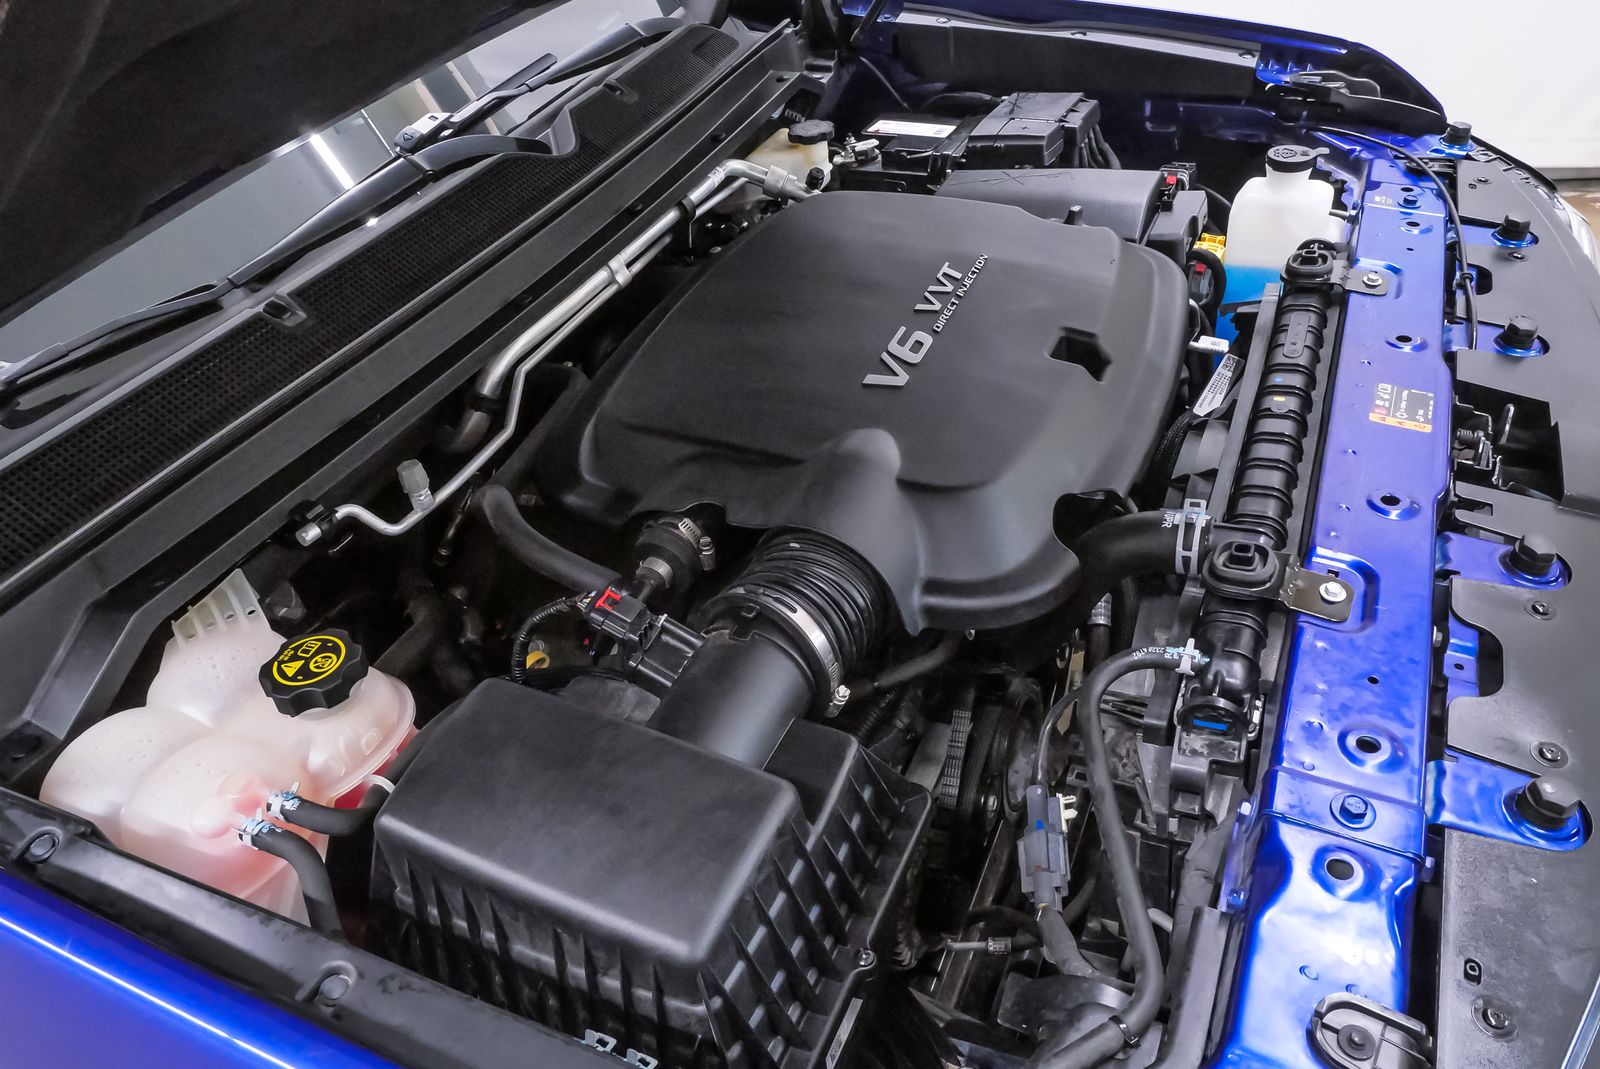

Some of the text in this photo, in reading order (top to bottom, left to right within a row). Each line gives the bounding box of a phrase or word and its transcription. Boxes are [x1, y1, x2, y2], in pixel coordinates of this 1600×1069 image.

[862, 261, 963, 386] V6 VVT
[933, 253, 989, 333] DIRECT INJECTION
